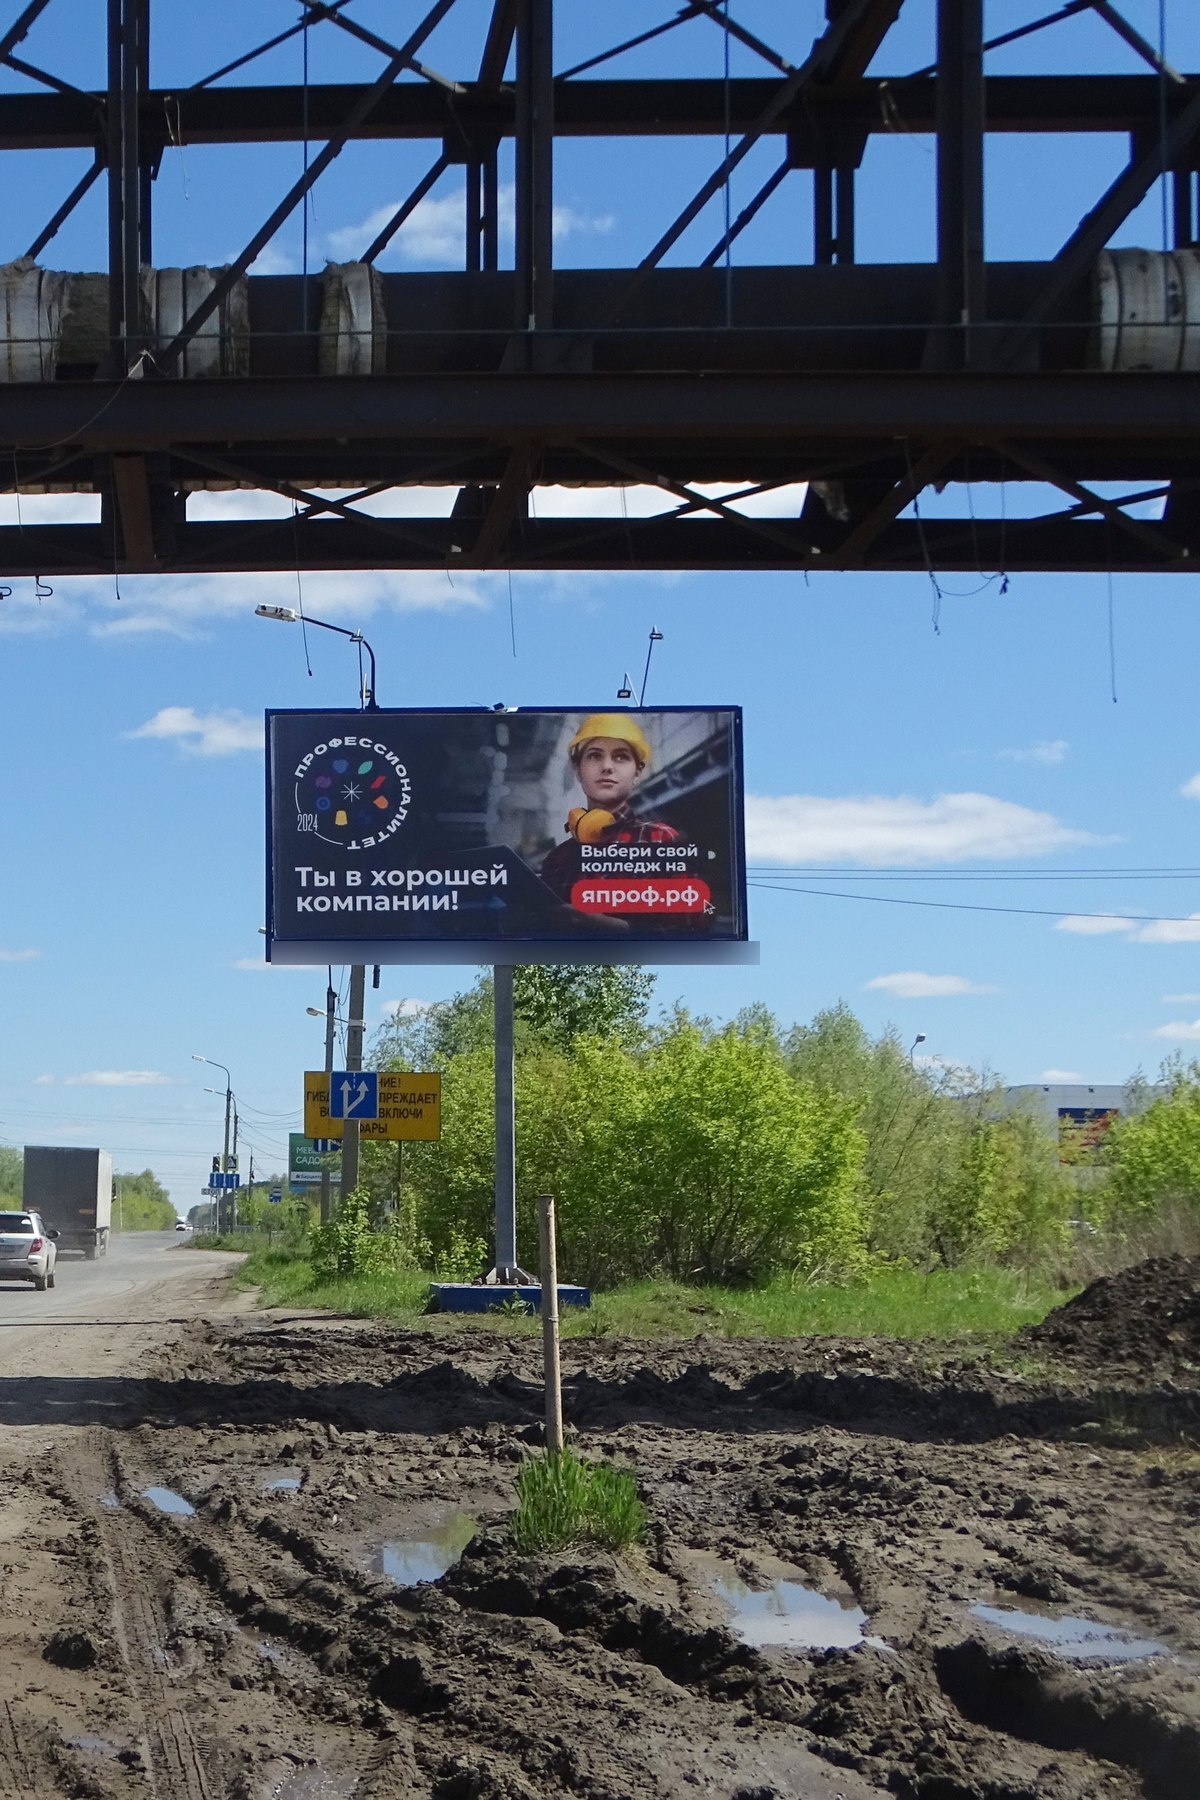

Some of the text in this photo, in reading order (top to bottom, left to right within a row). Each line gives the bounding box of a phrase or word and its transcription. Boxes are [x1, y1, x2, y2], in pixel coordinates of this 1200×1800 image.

[294, 736, 412, 850] ПРОФЕССИОНАЛИТЕТ
[297, 813, 318, 832] 2024
[581, 843, 698, 860] Выбери свой
[294, 863, 508, 891] Ты в хорошей
[581, 861, 687, 874] колледж на
[296, 890, 458, 912] компании!
[581, 885, 699, 907] япроф.рф
[379, 1091, 437, 1104] ПРЕЖДАЕТ
[378, 1107, 423, 1119] ВКЛЮЧИ
